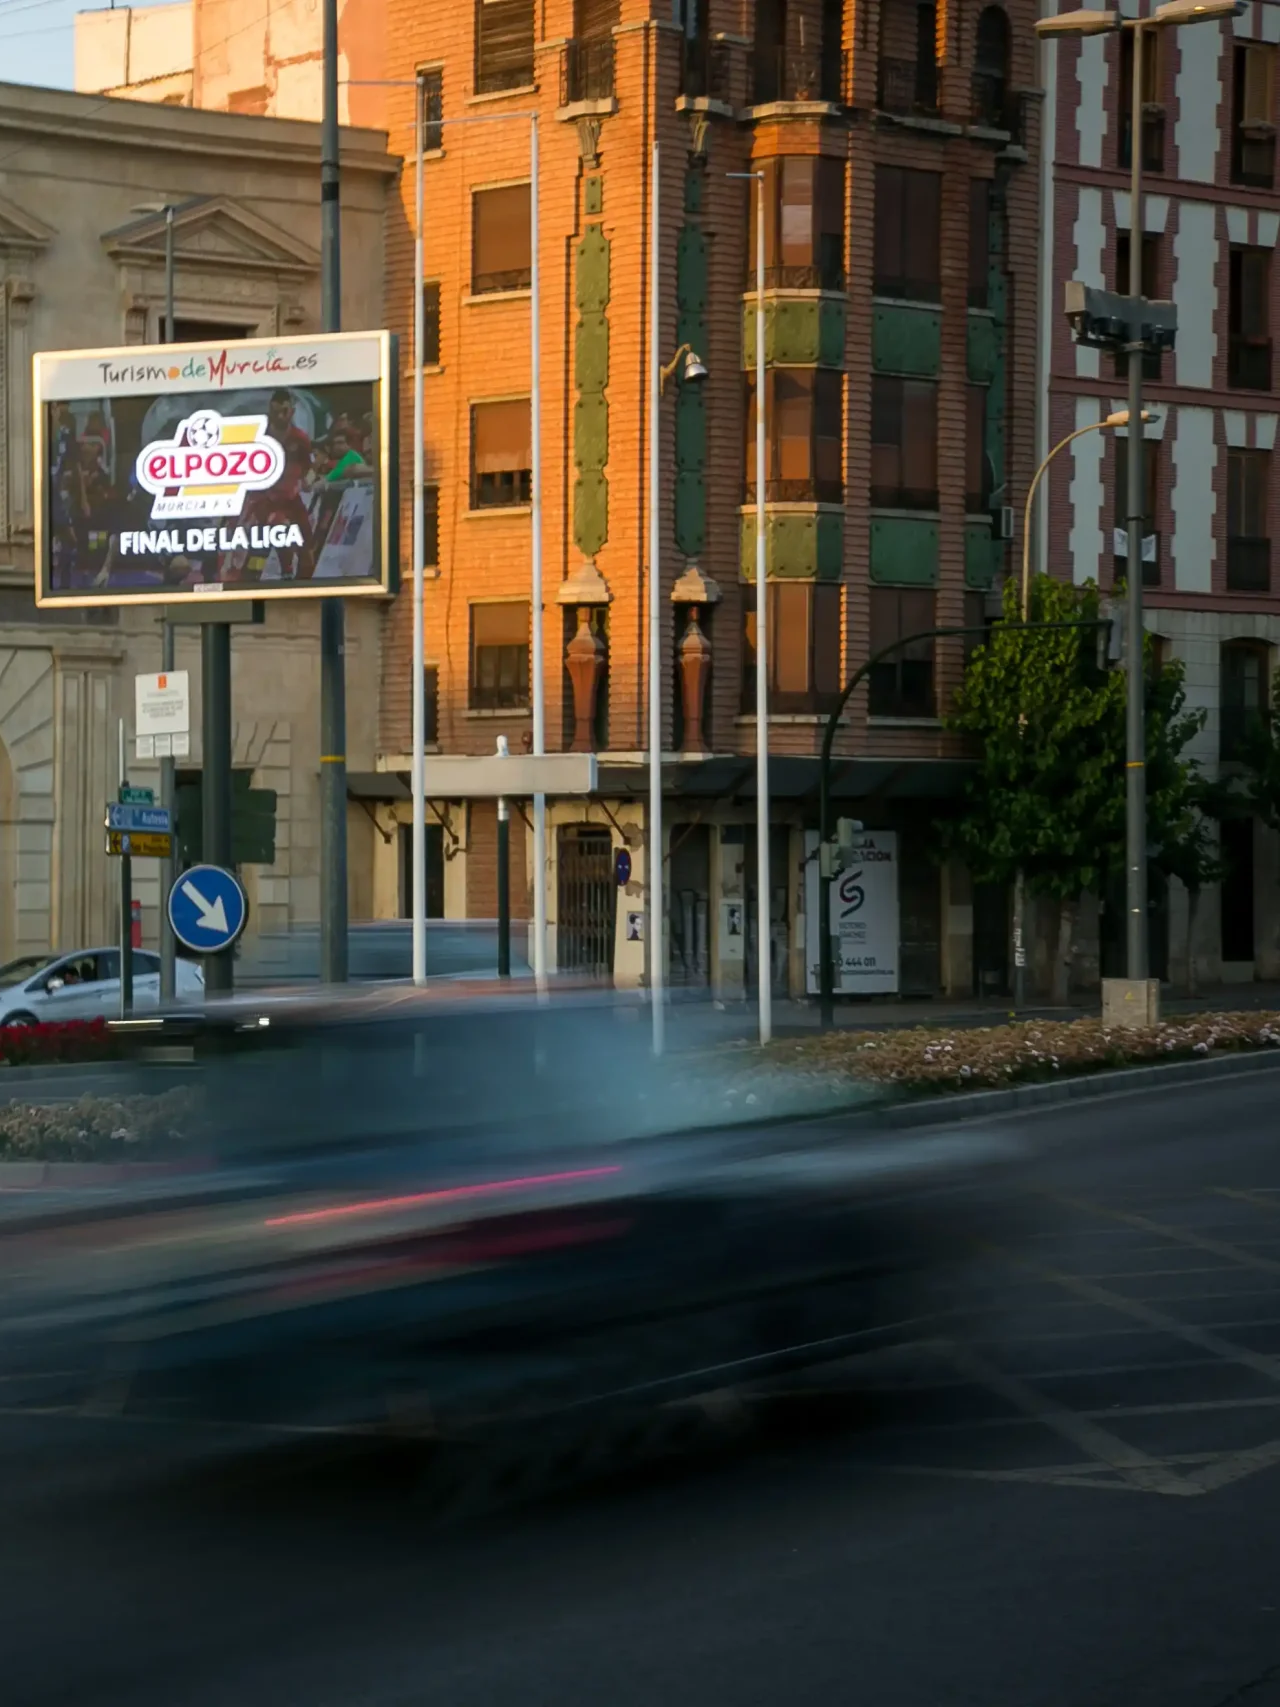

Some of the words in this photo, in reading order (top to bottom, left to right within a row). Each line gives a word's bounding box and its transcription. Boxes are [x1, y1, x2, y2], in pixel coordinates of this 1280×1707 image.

[155, 500, 206, 512] MURCIA
[120, 530, 184, 555] FINAL
[186, 528, 218, 552] DE
[219, 526, 249, 550] LA
[250, 524, 304, 549] LIGA
